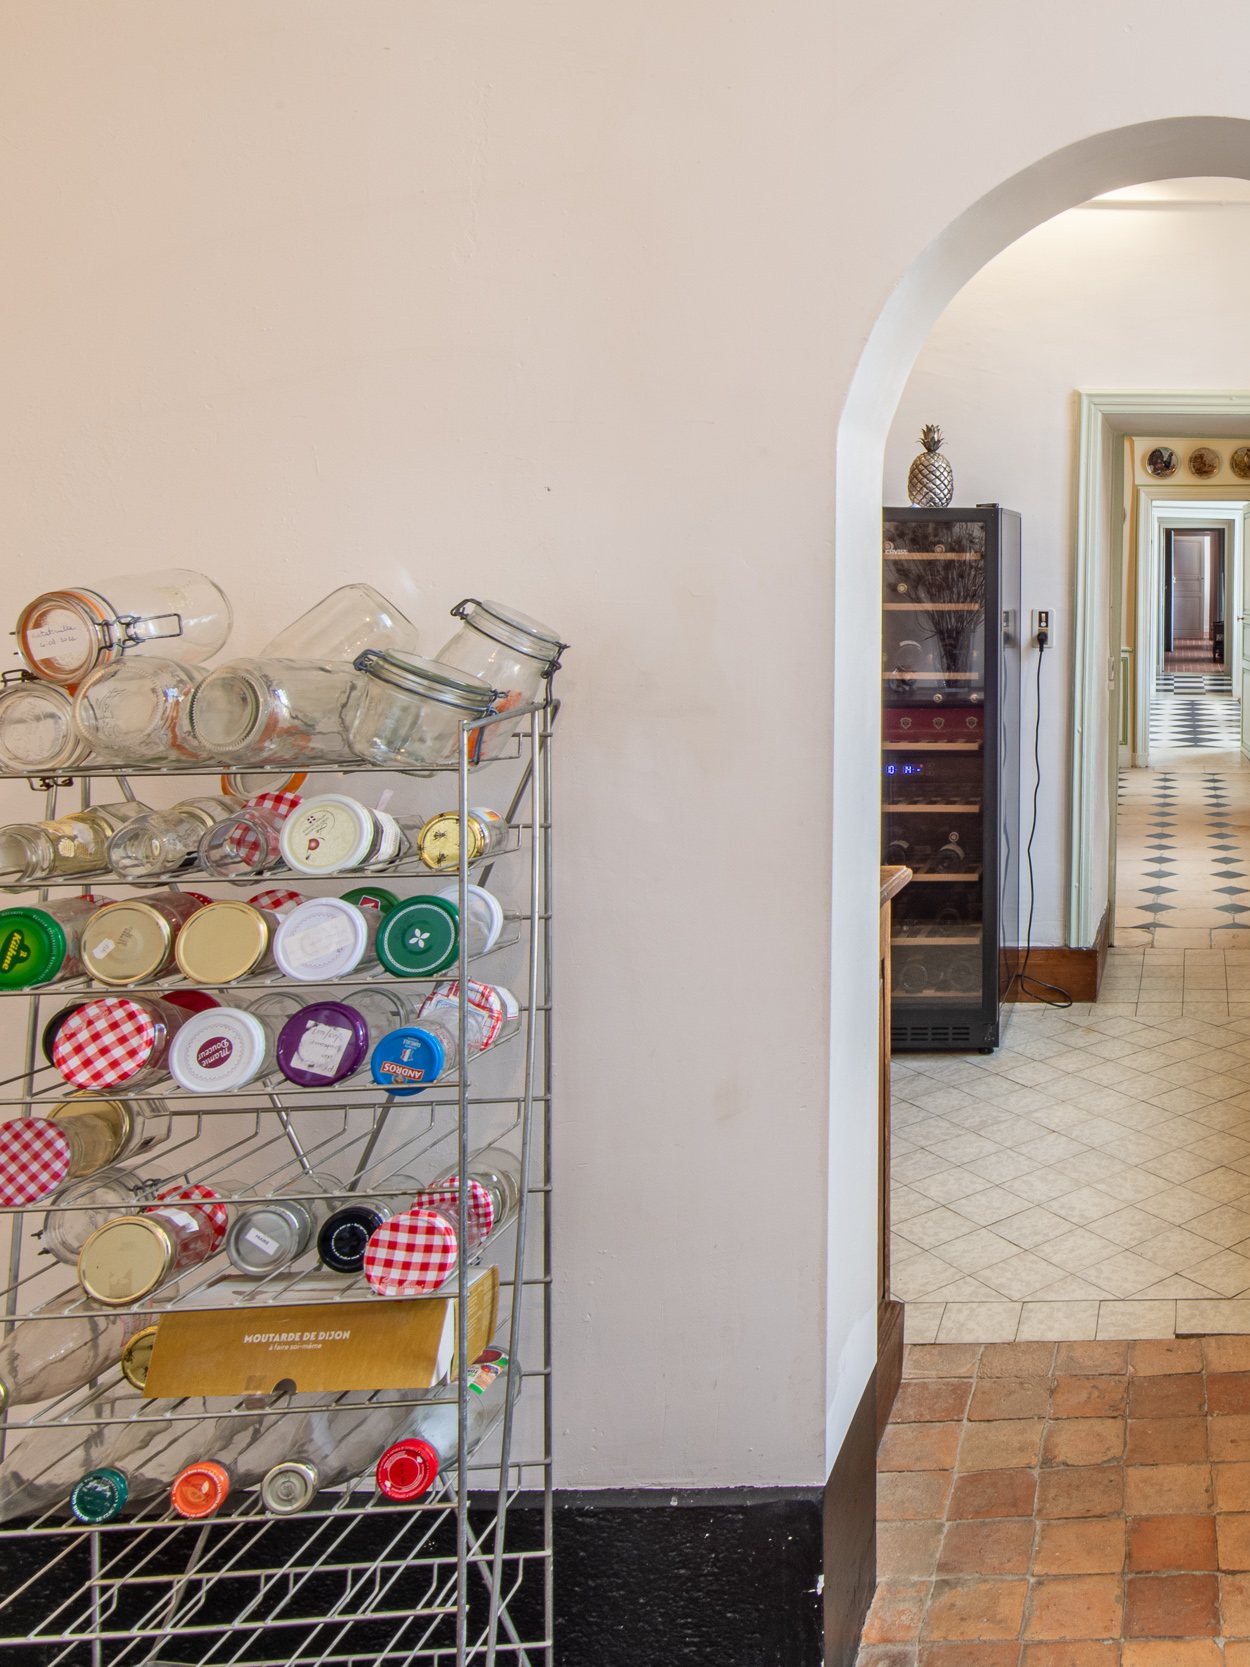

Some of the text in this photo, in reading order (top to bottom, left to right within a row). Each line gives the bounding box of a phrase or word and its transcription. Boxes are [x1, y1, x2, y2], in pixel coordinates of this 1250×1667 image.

[197, 1038, 230, 1061] Douceur
[201, 1047, 232, 1067] Mamie
[383, 1063, 422, 1079] ANDROS
[243, 1330, 351, 1343] MOUTARDE DE DIJON
[290, 1342, 322, 1350] soi-même
